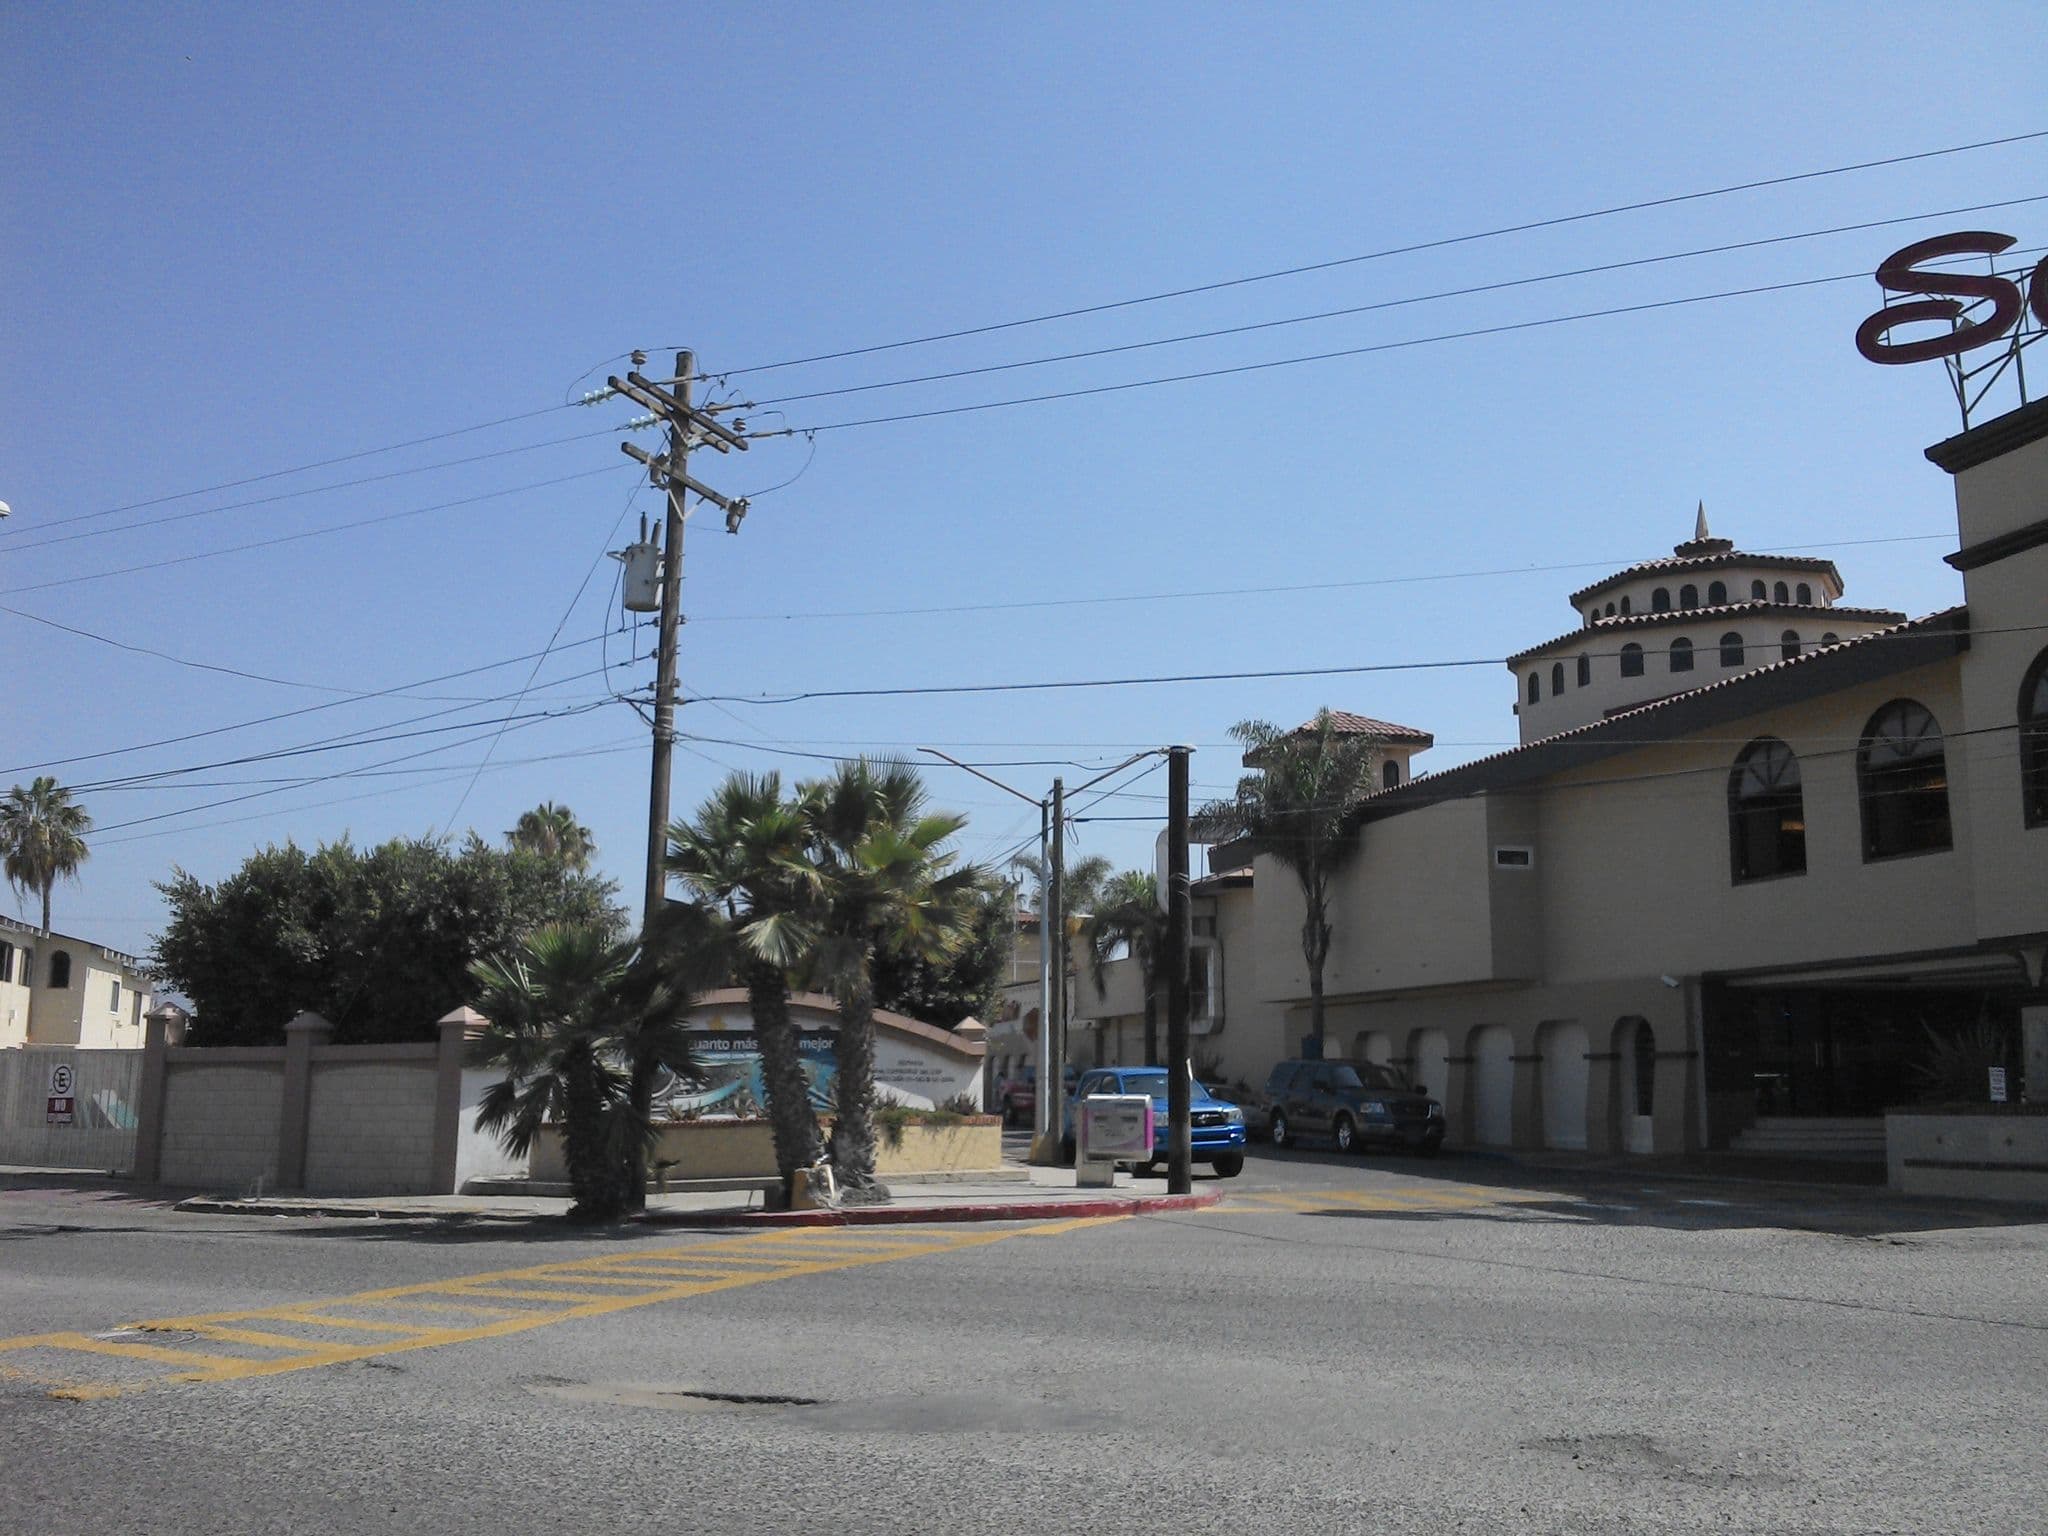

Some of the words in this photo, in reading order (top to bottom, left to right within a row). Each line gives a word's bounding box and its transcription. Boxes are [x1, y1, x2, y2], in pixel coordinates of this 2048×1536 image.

[1855, 231, 2048, 366] S
[733, 1037, 759, 1050] más
[799, 1037, 834, 1053] mejor
[58, 1073, 66, 1087] E
